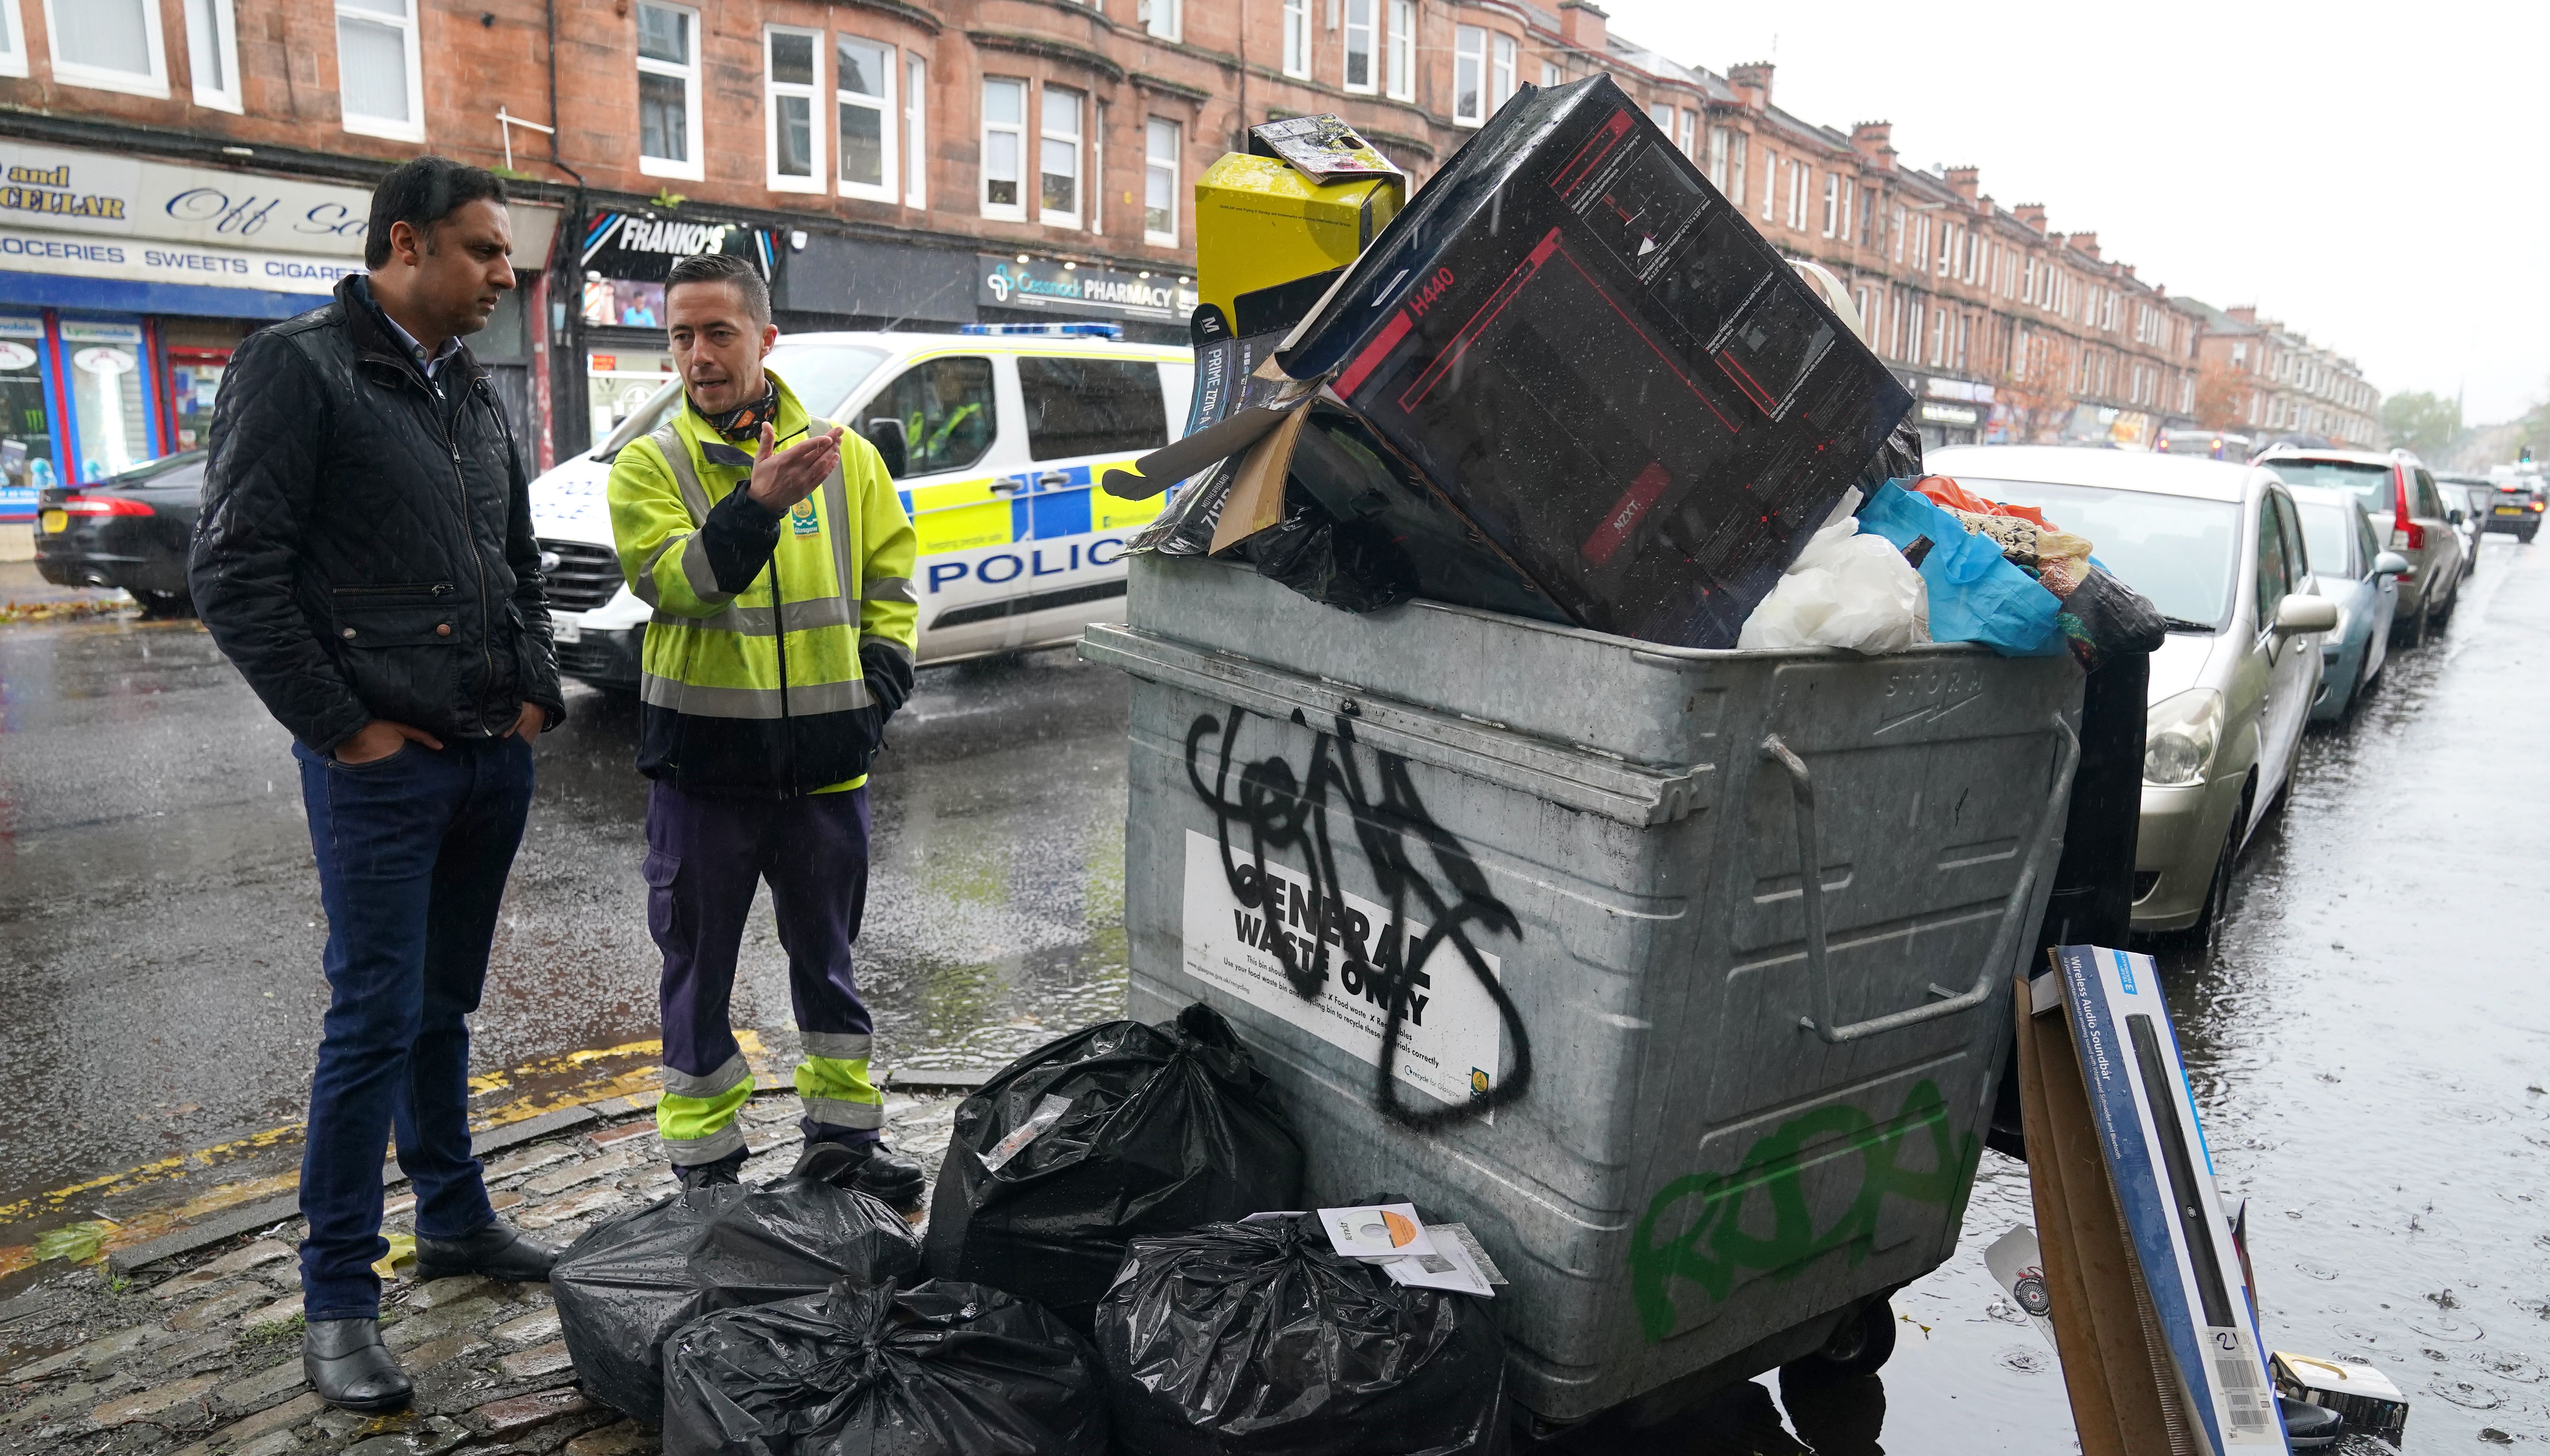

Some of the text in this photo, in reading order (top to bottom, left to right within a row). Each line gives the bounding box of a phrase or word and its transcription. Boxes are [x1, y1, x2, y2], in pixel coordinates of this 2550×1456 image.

[8, 165, 70, 187] and
[0, 187, 125, 220] CELLAR
[166, 187, 280, 235] Off
[0, 238, 125, 263] OCERIES
[619, 217, 725, 255] FRANKO'S
[145, 250, 248, 274] SWEETS
[1084, 279, 1173, 308] PHARMACY
[1409, 267, 1455, 318] H440
[1207, 348, 1222, 389] PRIME
[1201, 473, 1230, 509] MOTHERBOARD
[1613, 500, 1640, 532] NZXT
[928, 539, 1123, 594] POLIC
[1234, 909, 1329, 982] WASTE
[1187, 960, 1250, 995] www.glasgow.gov.uk/recycling
[2119, 952, 2133, 984] WARRANTY
[1247, 955, 1257, 966] This
[1258, 959, 1267, 970] bin
[1268, 964, 1287, 979] should
[1334, 996, 1349, 1009] Food
[1350, 1004, 1366, 1019] waste
[2125, 982, 2134, 993] 3
[1224, 957, 1233, 967] Use
[1235, 963, 1247, 975] your
[1248, 968, 1260, 980] food
[1262, 975, 1277, 987] waste
[1279, 981, 1288, 992] bin
[1289, 987, 1299, 998] and
[1326, 1004, 1335, 1016] bin
[1337, 1010, 1342, 1019] to
[1344, 1015, 1363, 1030] recycle
[1365, 1024, 1381, 1039] these
[1412, 1048, 1439, 1068] correctly
[2070, 955, 2111, 1081] Wireless Audio Soundbar
[1413, 1071, 1428, 1083] recycle
[2078, 1016, 2088, 1038] amazing
[2085, 1038, 2093, 1054] sound
[2099, 1093, 2112, 1122] Subwoofer
[2109, 1132, 2122, 1159] Bluetooth
